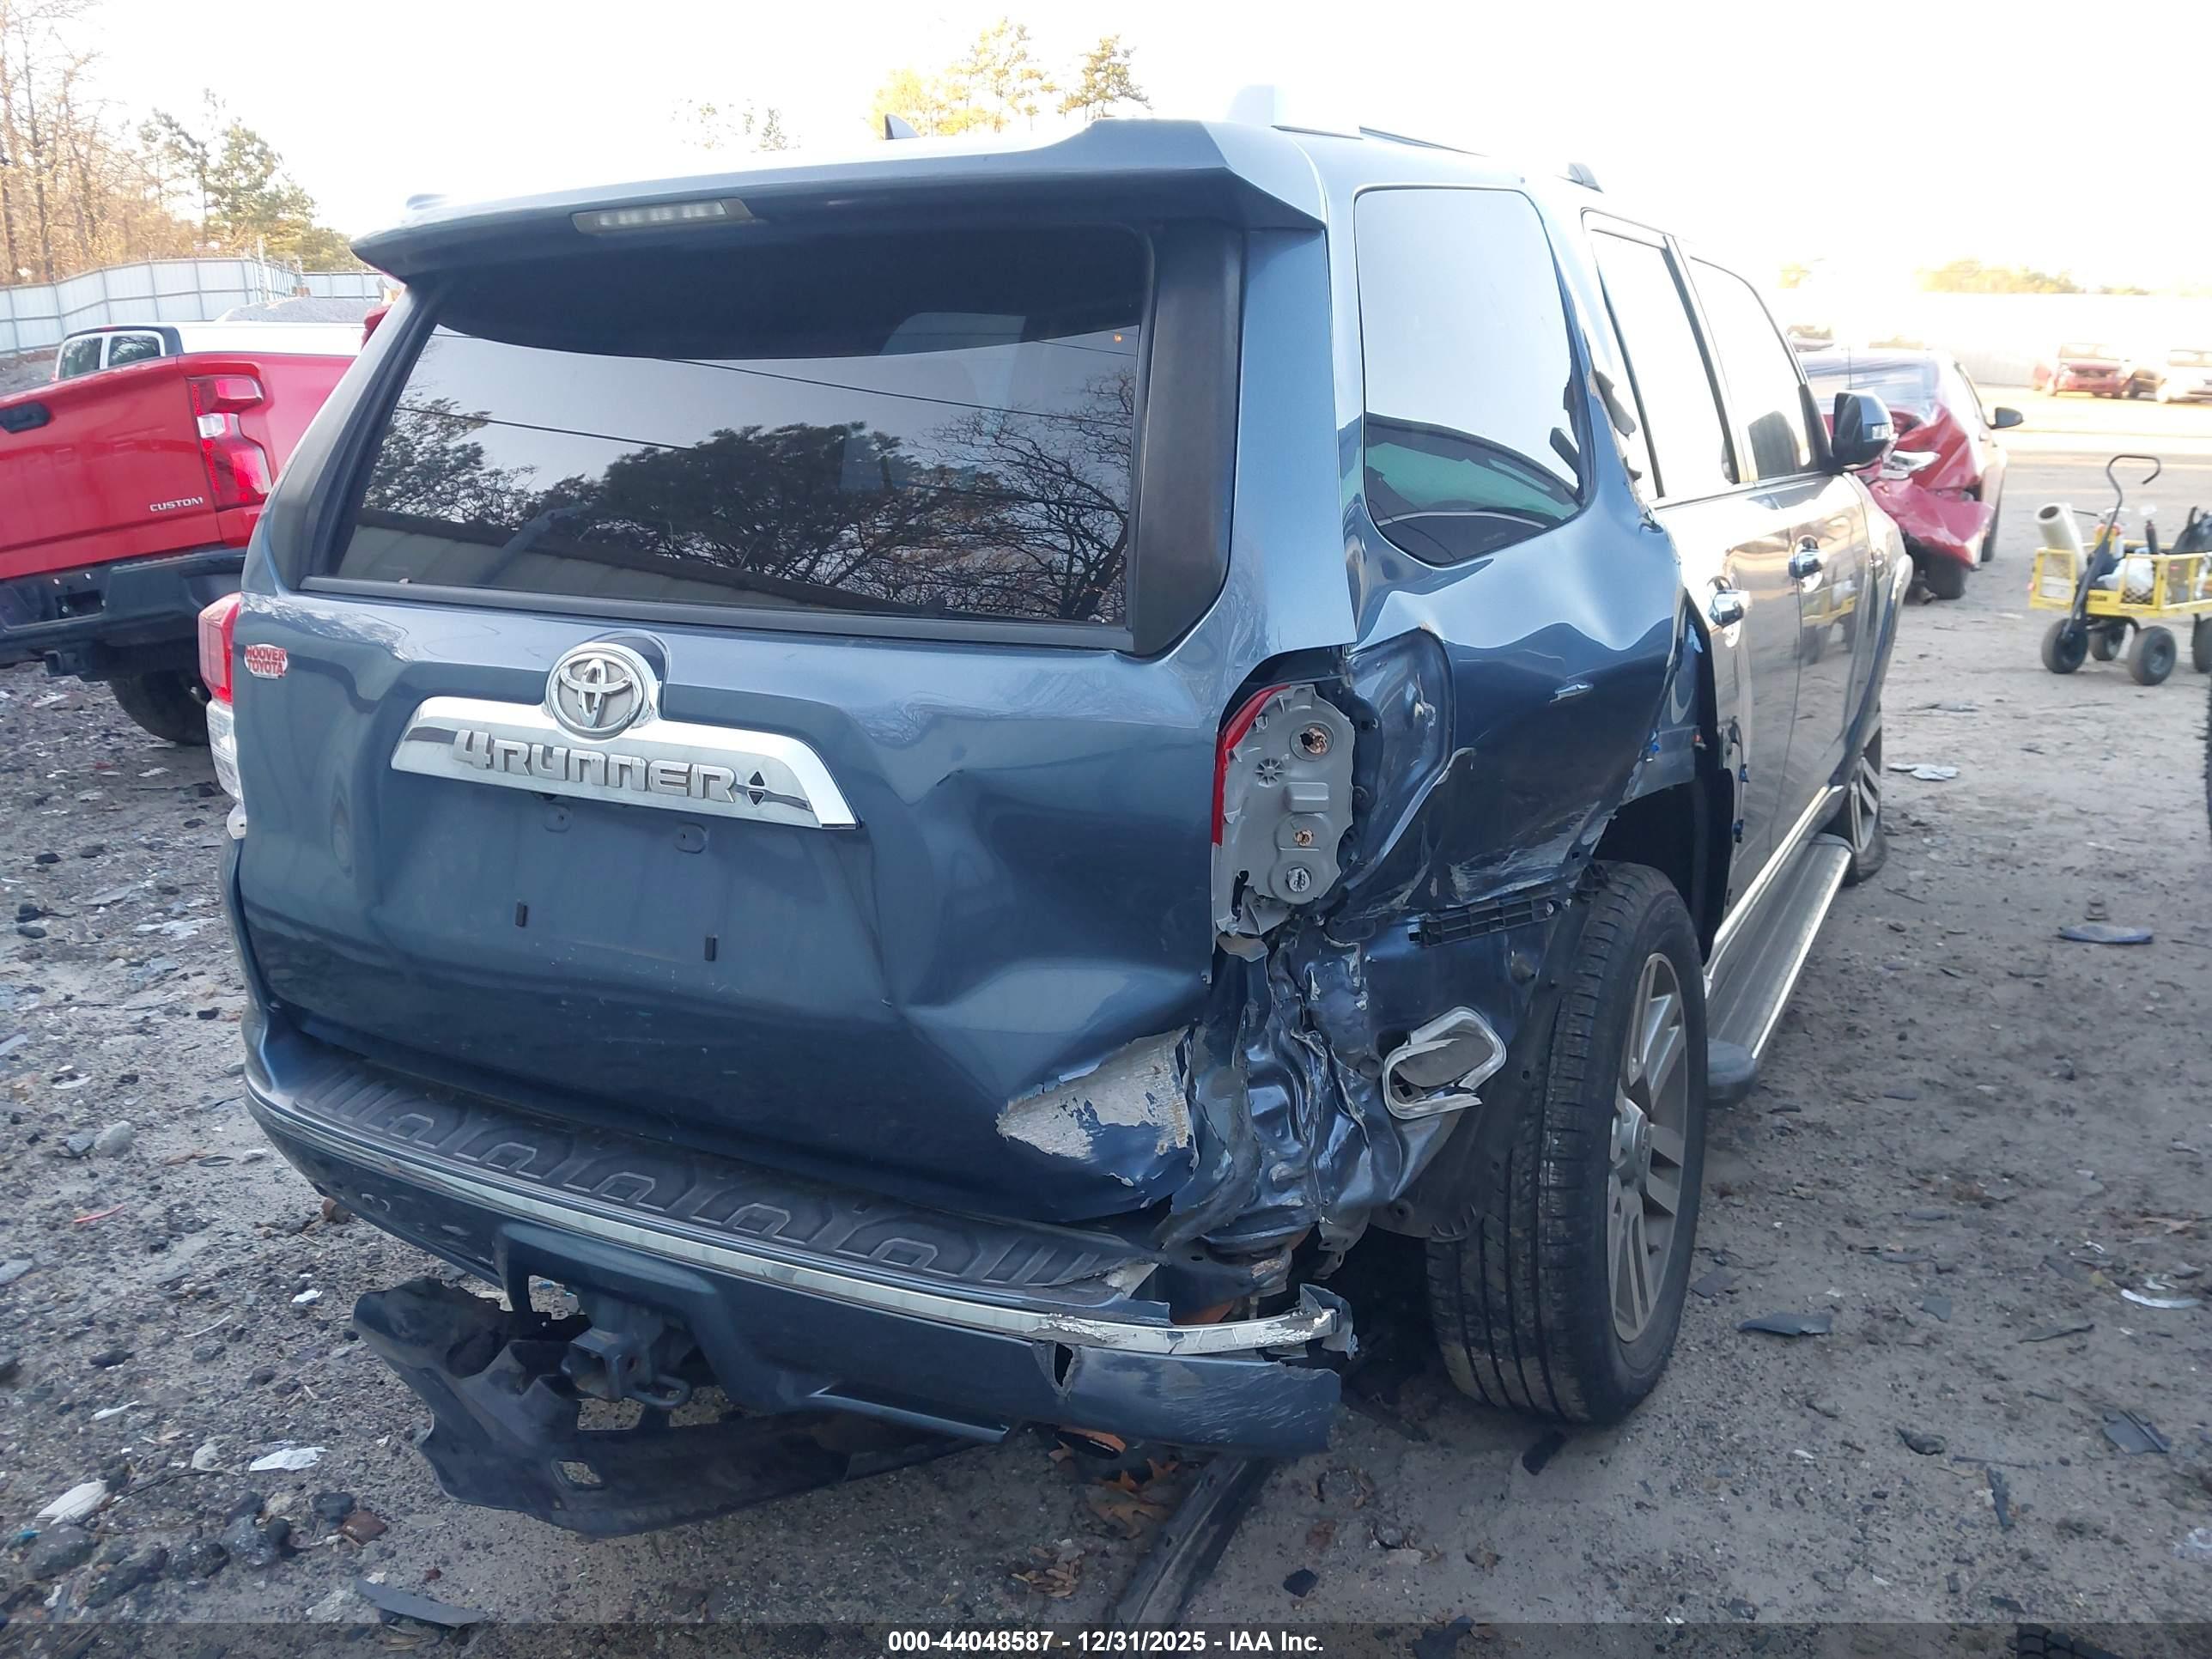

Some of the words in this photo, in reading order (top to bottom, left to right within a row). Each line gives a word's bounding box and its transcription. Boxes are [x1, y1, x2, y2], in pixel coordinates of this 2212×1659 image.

[149, 496, 204, 512] CUSTOM
[246, 646, 285, 661] HOOVER
[246, 659, 284, 675] TOYOTA
[452, 729, 736, 803] 4RUNNER
